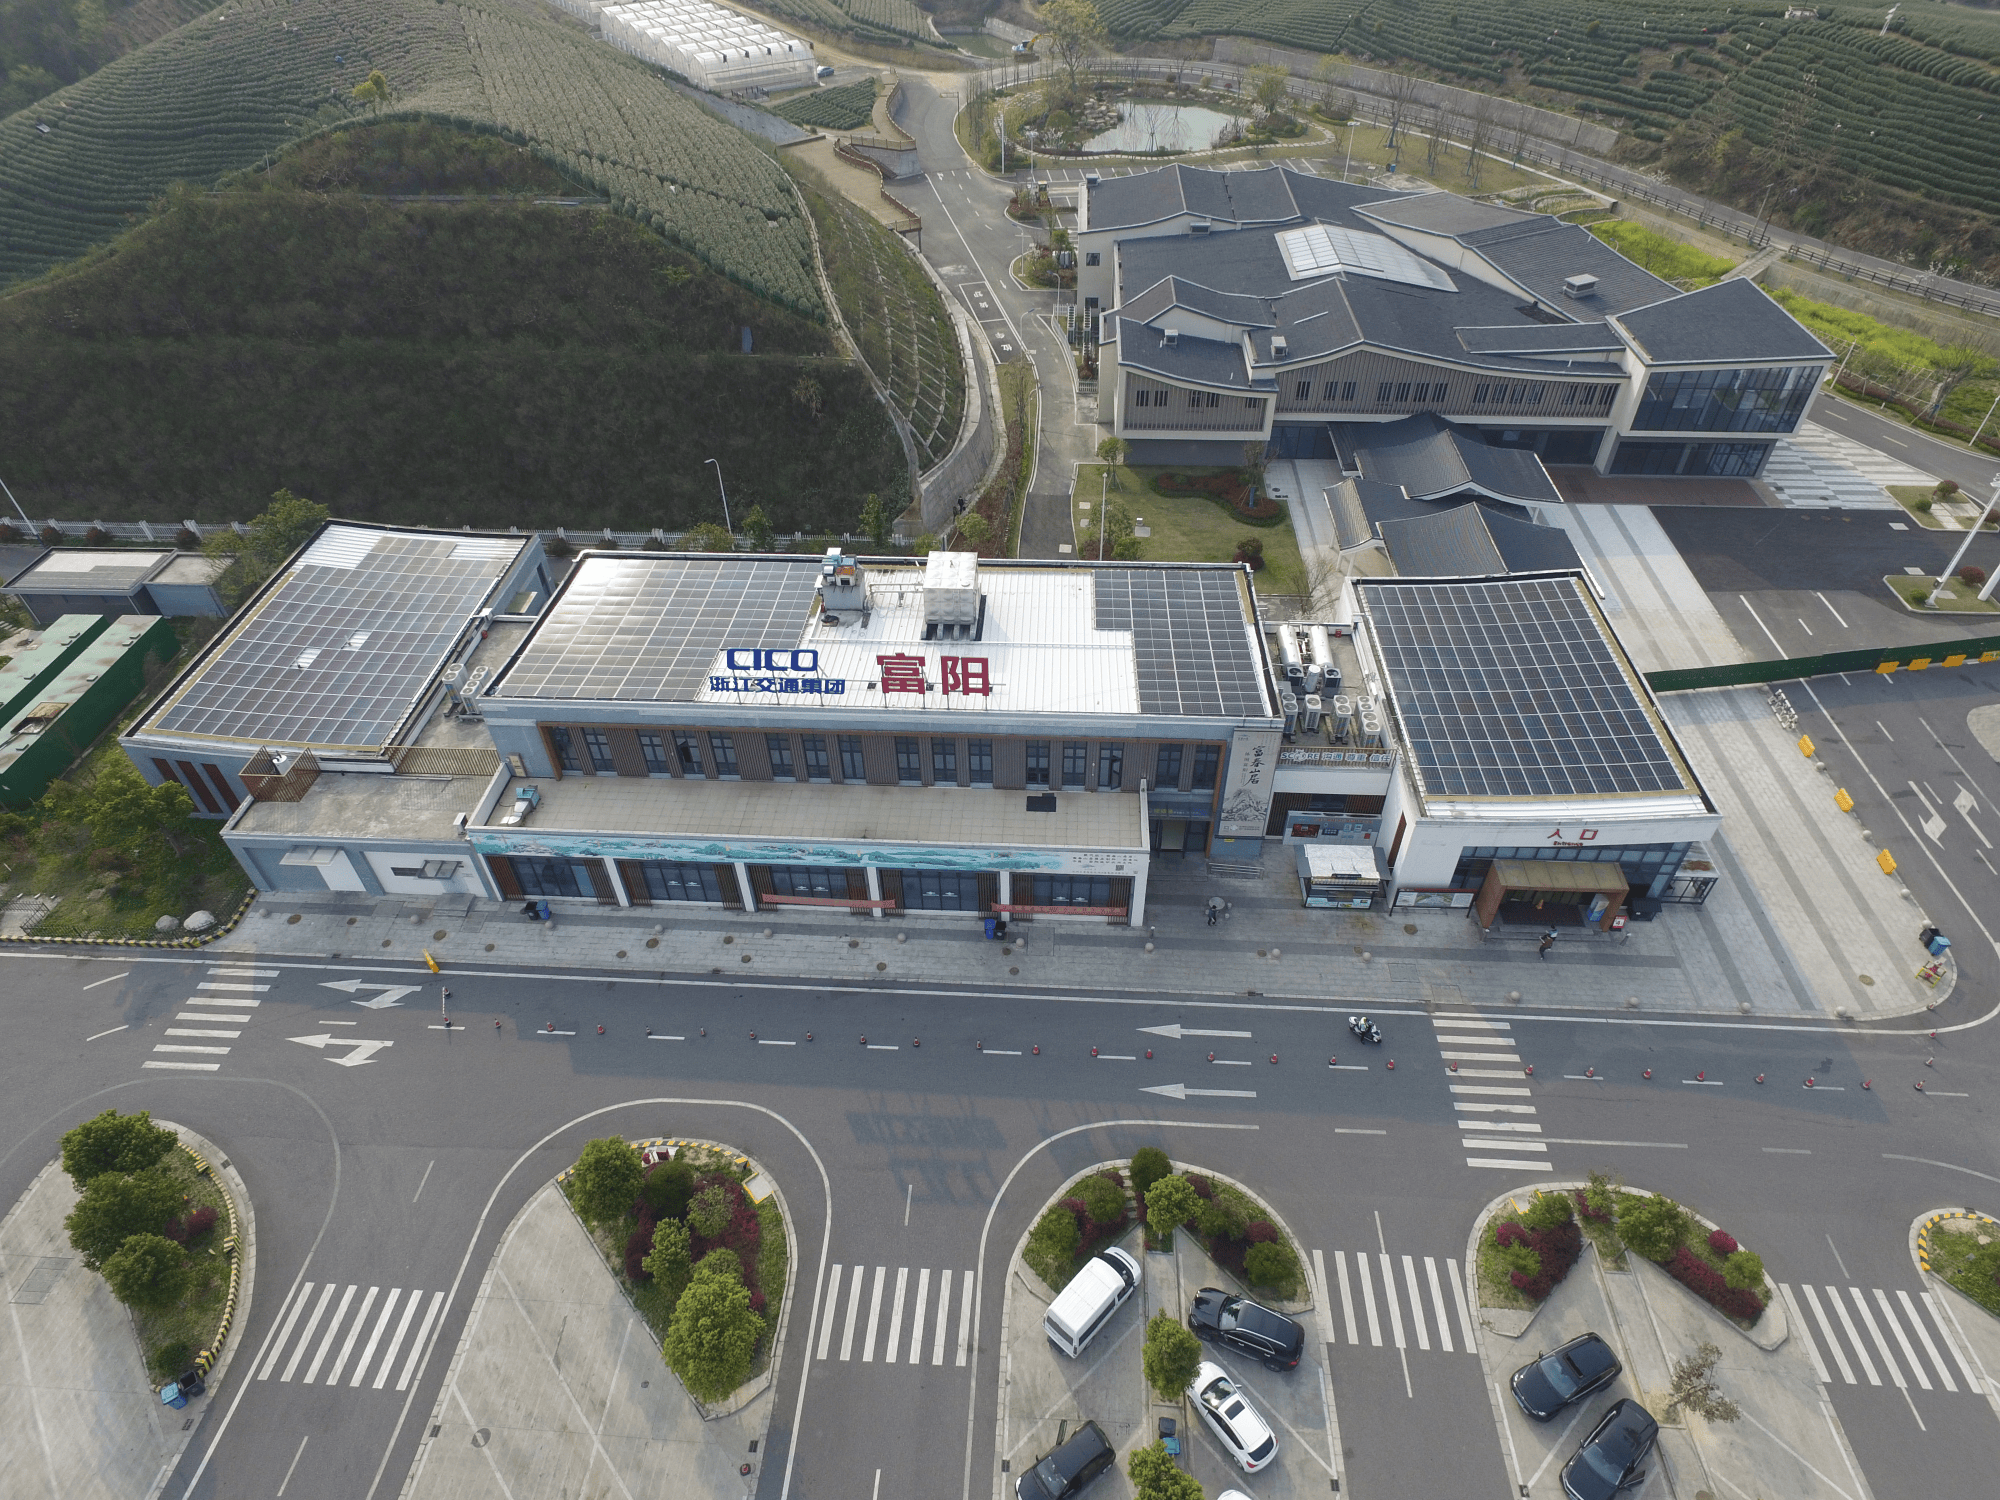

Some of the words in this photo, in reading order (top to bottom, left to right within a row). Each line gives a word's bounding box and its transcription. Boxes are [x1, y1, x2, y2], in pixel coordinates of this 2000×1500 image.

[727, 648, 819, 672] CICO
[709, 675, 846, 695] 浙江交通集团
[876, 652, 991, 696] 富阳
[1242, 745, 1266, 787] 富春山居
[1547, 828, 1598, 840] 入口
